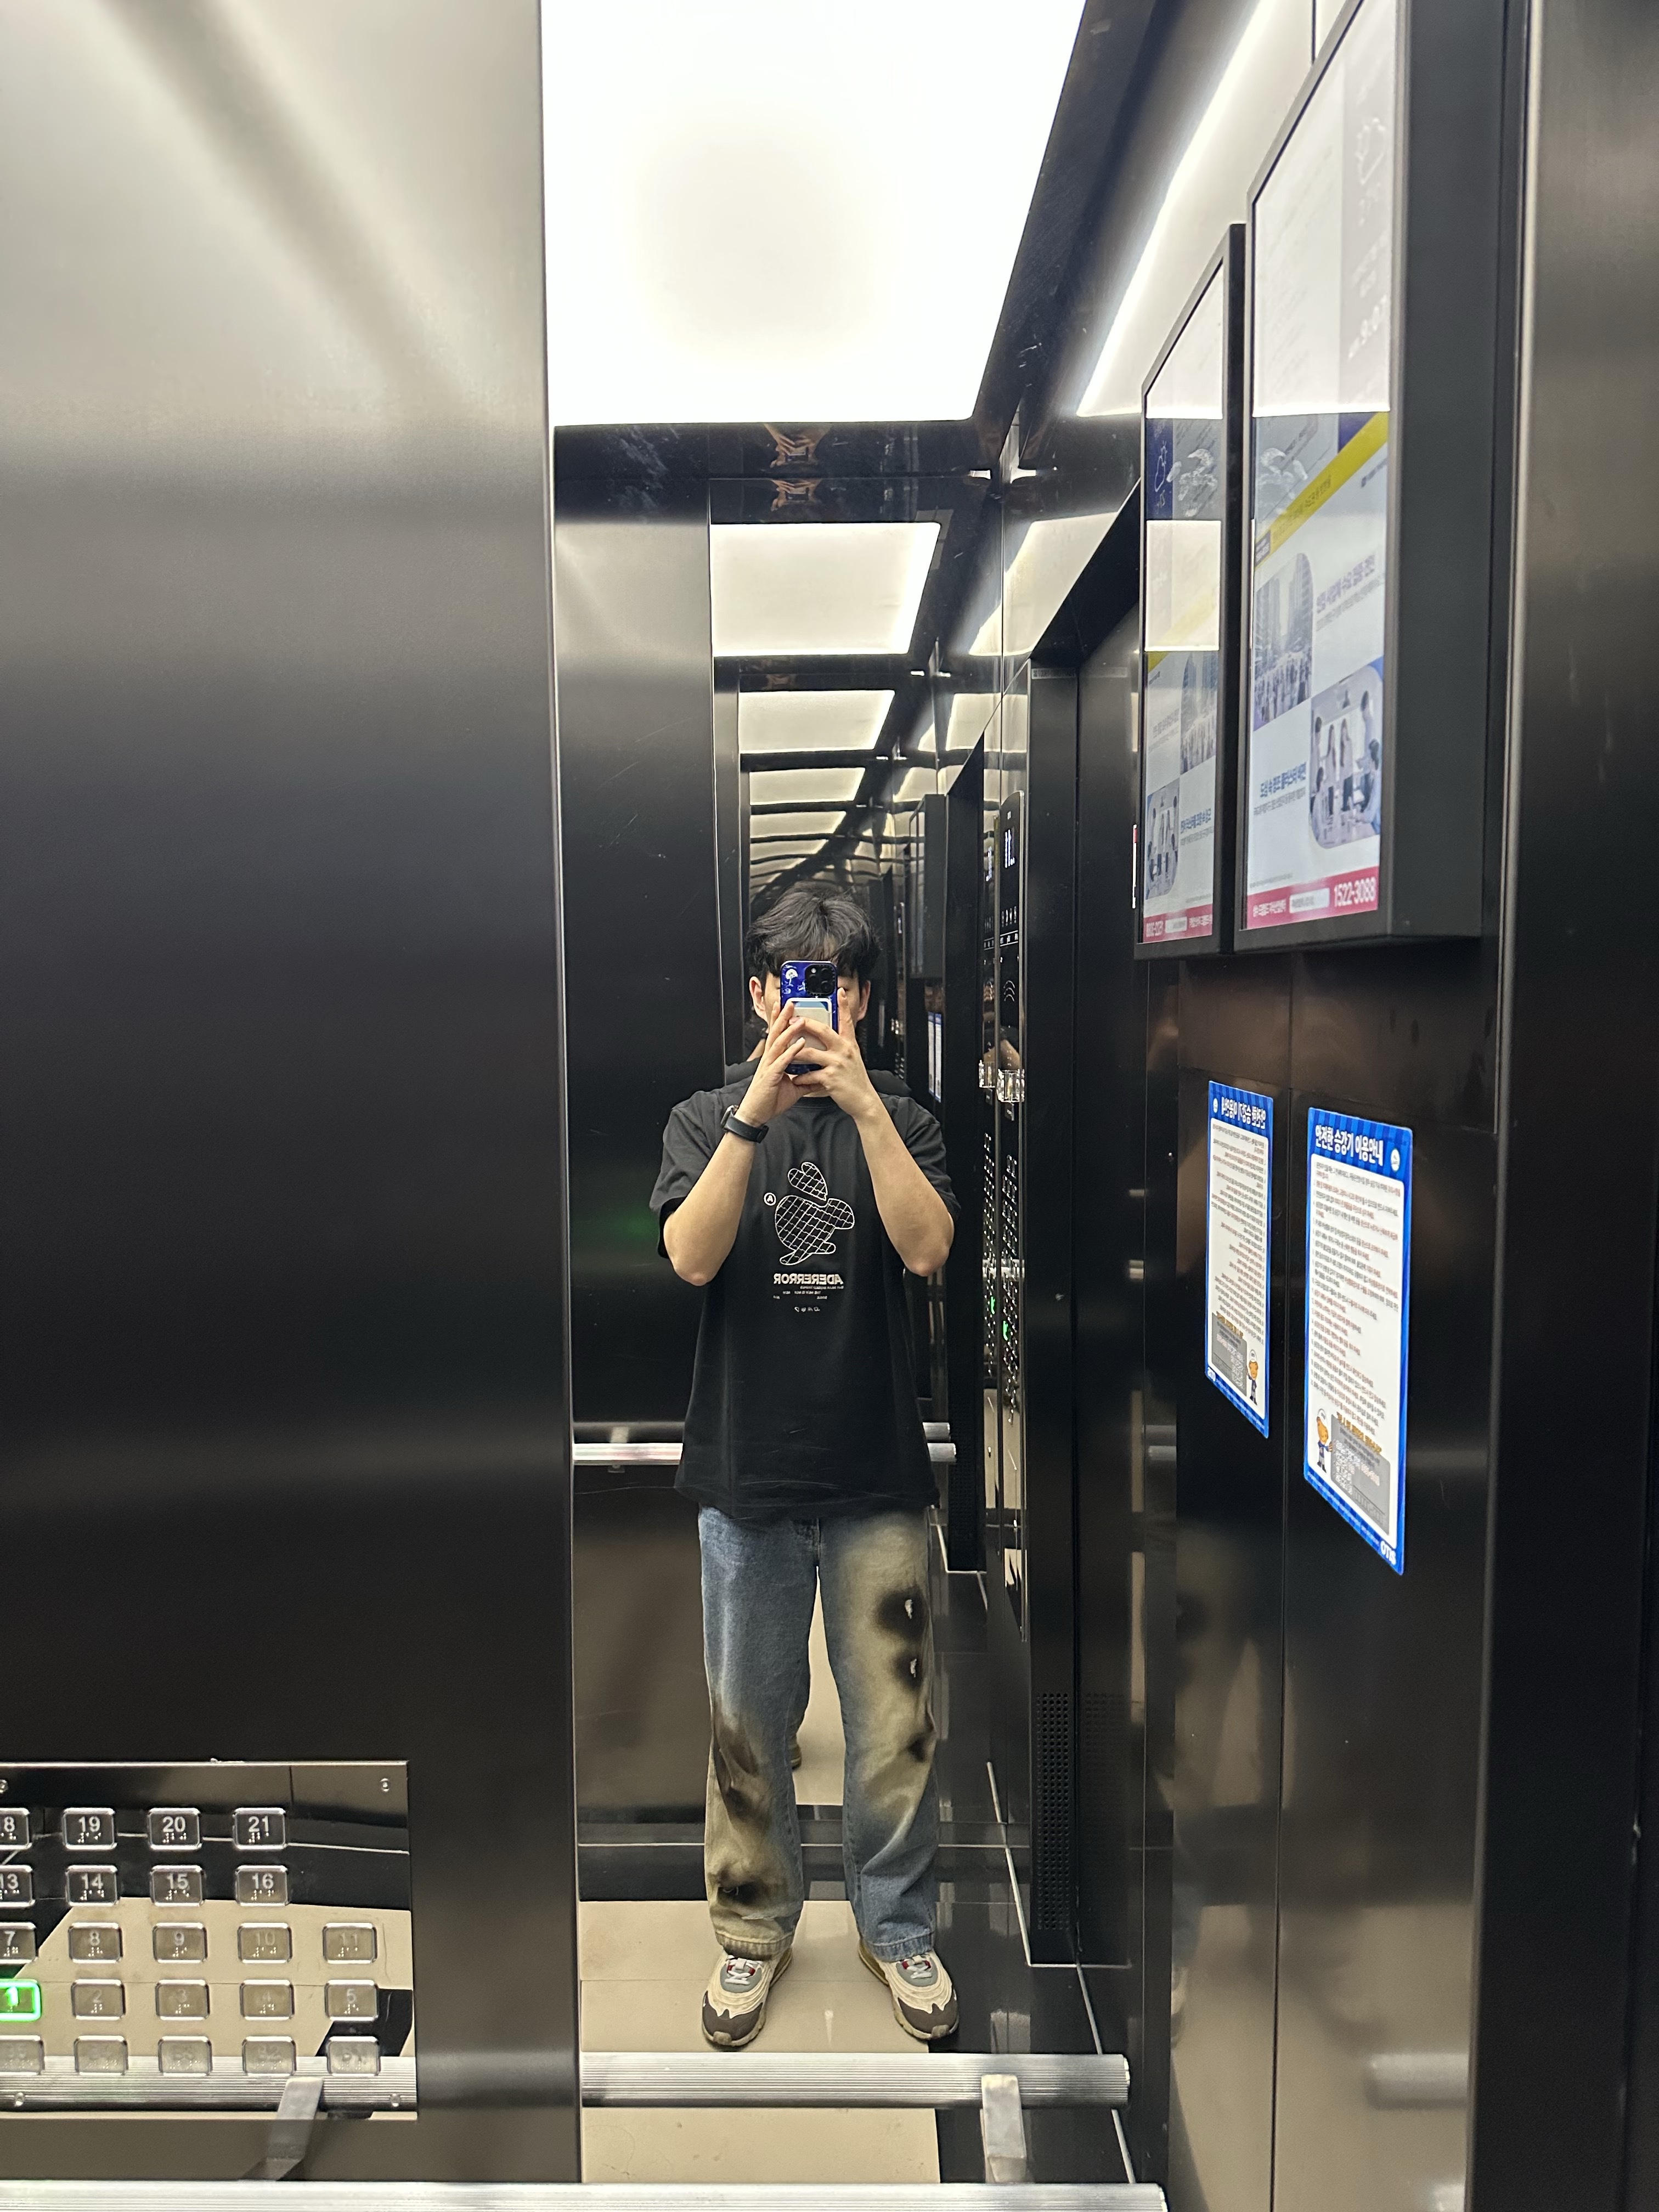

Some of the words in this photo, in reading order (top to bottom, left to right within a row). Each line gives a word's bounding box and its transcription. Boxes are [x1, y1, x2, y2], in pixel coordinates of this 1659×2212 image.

[1316, 1125, 1334, 1151] 안전한
[1334, 1129, 1354, 1158] 승강기
[1355, 1135, 1384, 1167] 이용안내
[1380, 1541, 1396, 1565] OTIS
[78, 1816, 101, 1832] 19
[162, 1816, 186, 1832] 20
[248, 1816, 269, 1832] 21
[81, 1874, 103, 1889] 14
[166, 1874, 189, 1890] 15
[252, 1873, 274, 1890] 16
[4, 1931, 15, 1946] 7
[89, 1931, 100, 1946] 8
[174, 1931, 185, 1946] 9
[255, 1931, 275, 1946] 10
[339, 1933, 358, 1946] 11
[6, 1987, 19, 2006] 1
[93, 1989, 103, 2003] 2
[177, 1989, 188, 2002] 3
[262, 1989, 272, 2002] 4
[346, 1988, 357, 2004] 5
